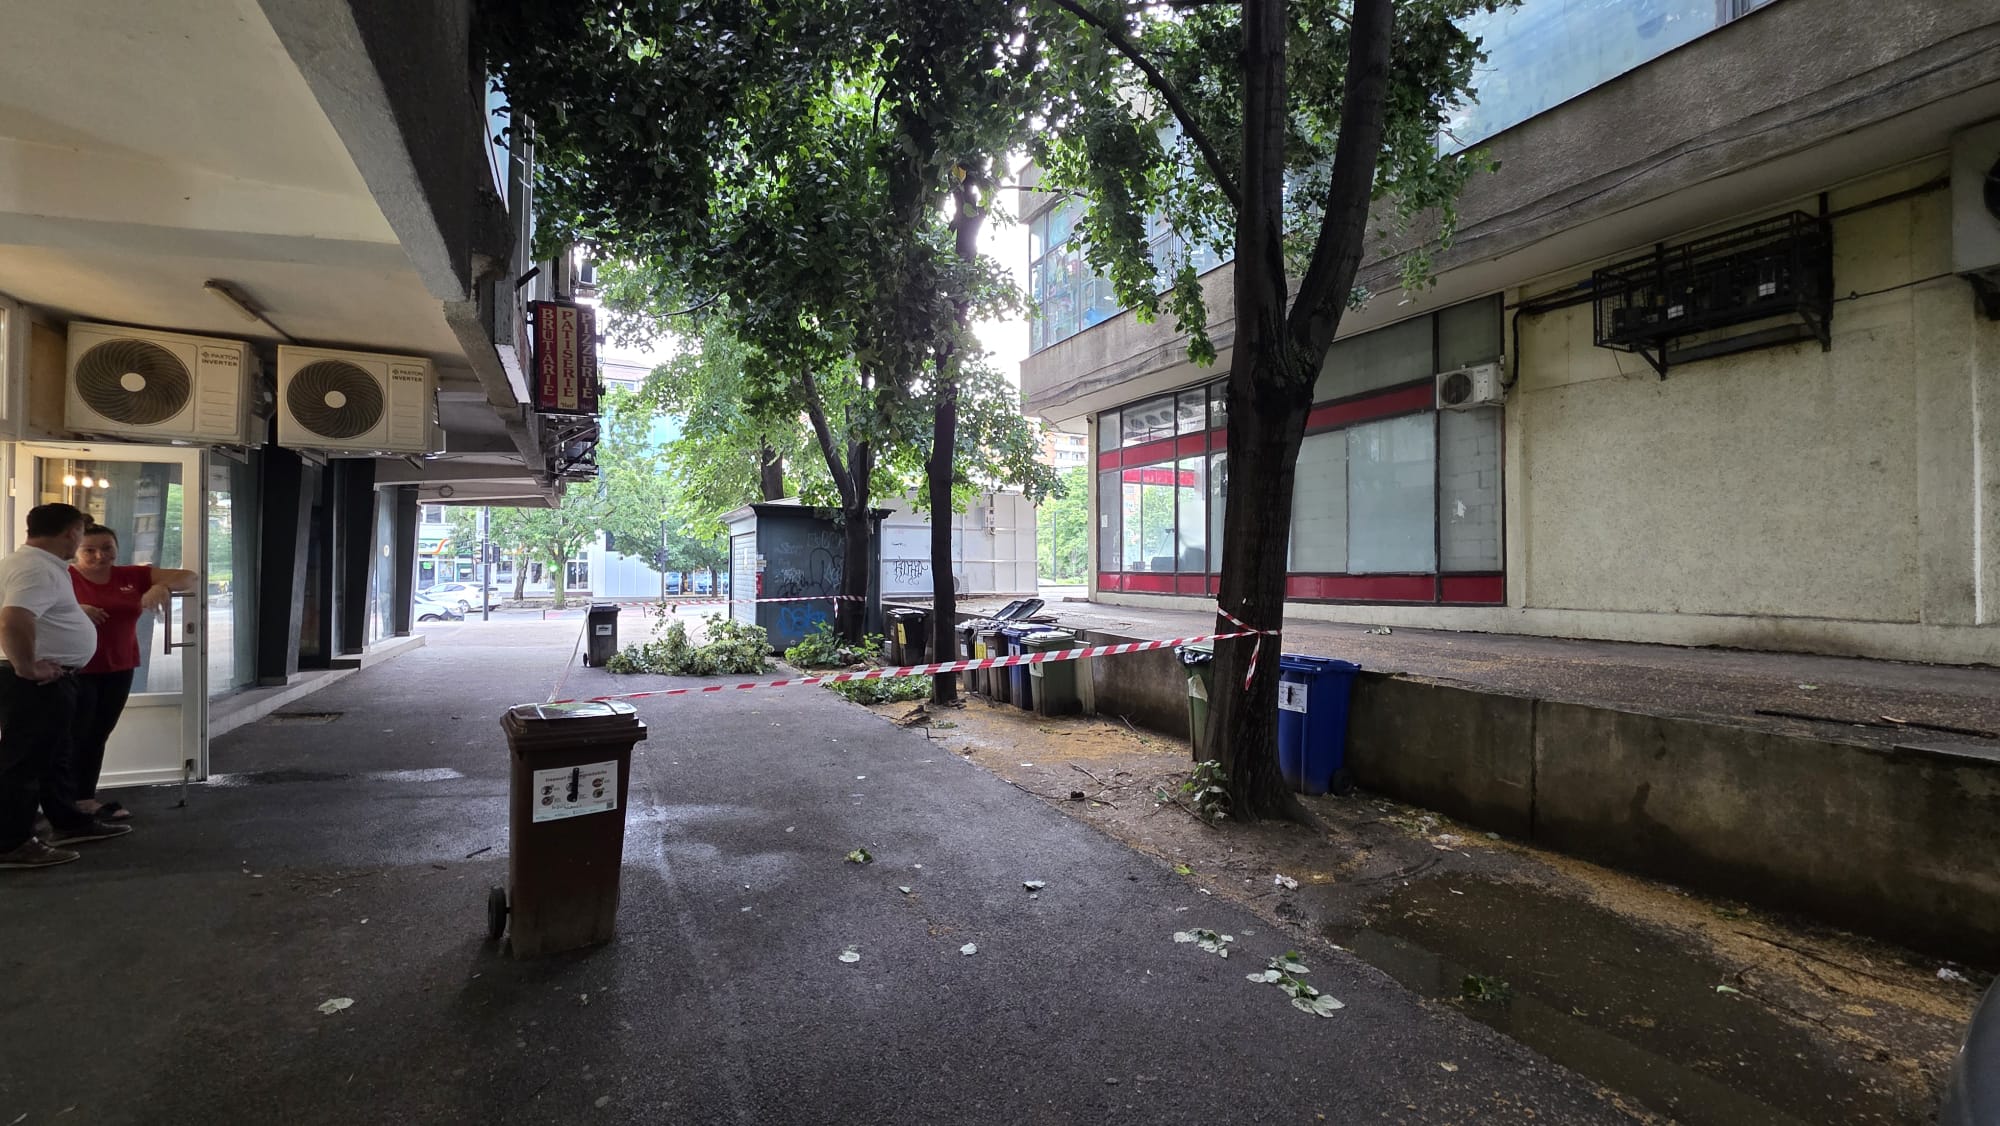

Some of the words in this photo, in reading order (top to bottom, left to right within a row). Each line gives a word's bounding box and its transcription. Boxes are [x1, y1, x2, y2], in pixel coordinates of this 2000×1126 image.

[201, 358, 238, 366] INVERTER
[562, 310, 575, 398] PATISERIE
[581, 312, 593, 399] PIZZERIE
